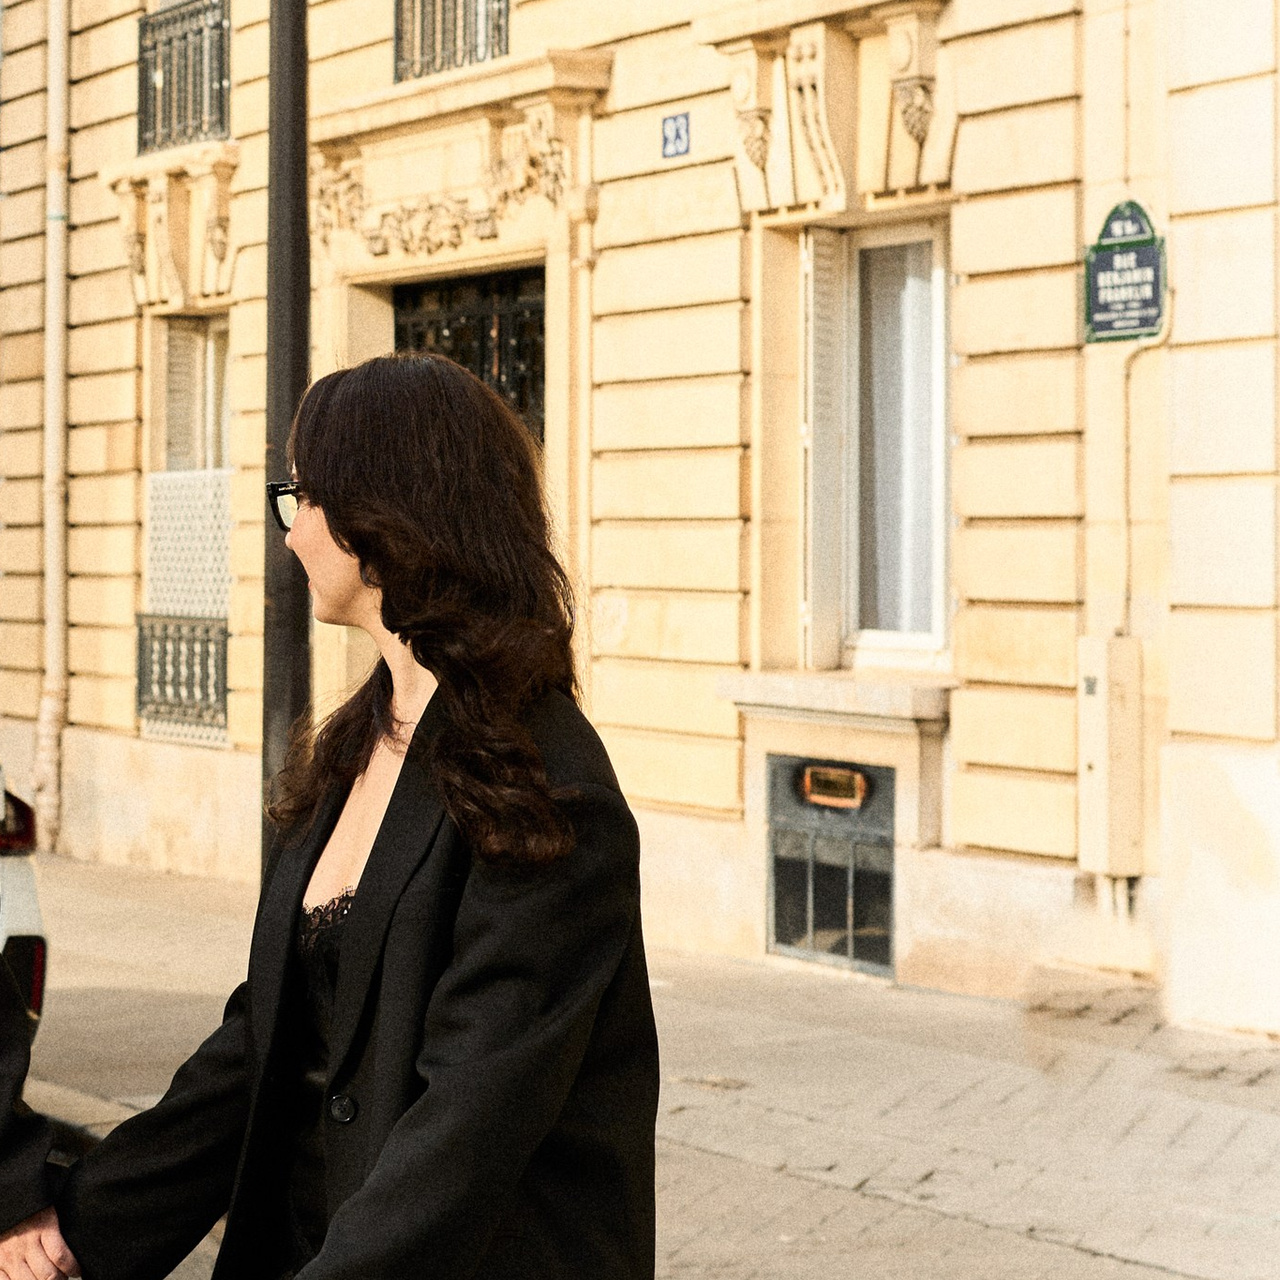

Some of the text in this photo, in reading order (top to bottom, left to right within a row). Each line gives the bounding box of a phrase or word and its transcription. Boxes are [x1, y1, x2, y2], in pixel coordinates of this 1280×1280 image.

[664, 116, 688, 157] 23
[1113, 252, 1137, 270] RUE
[1097, 267, 1154, 288] BENJAMIN
[1098, 283, 1153, 304] FRANKLIN
